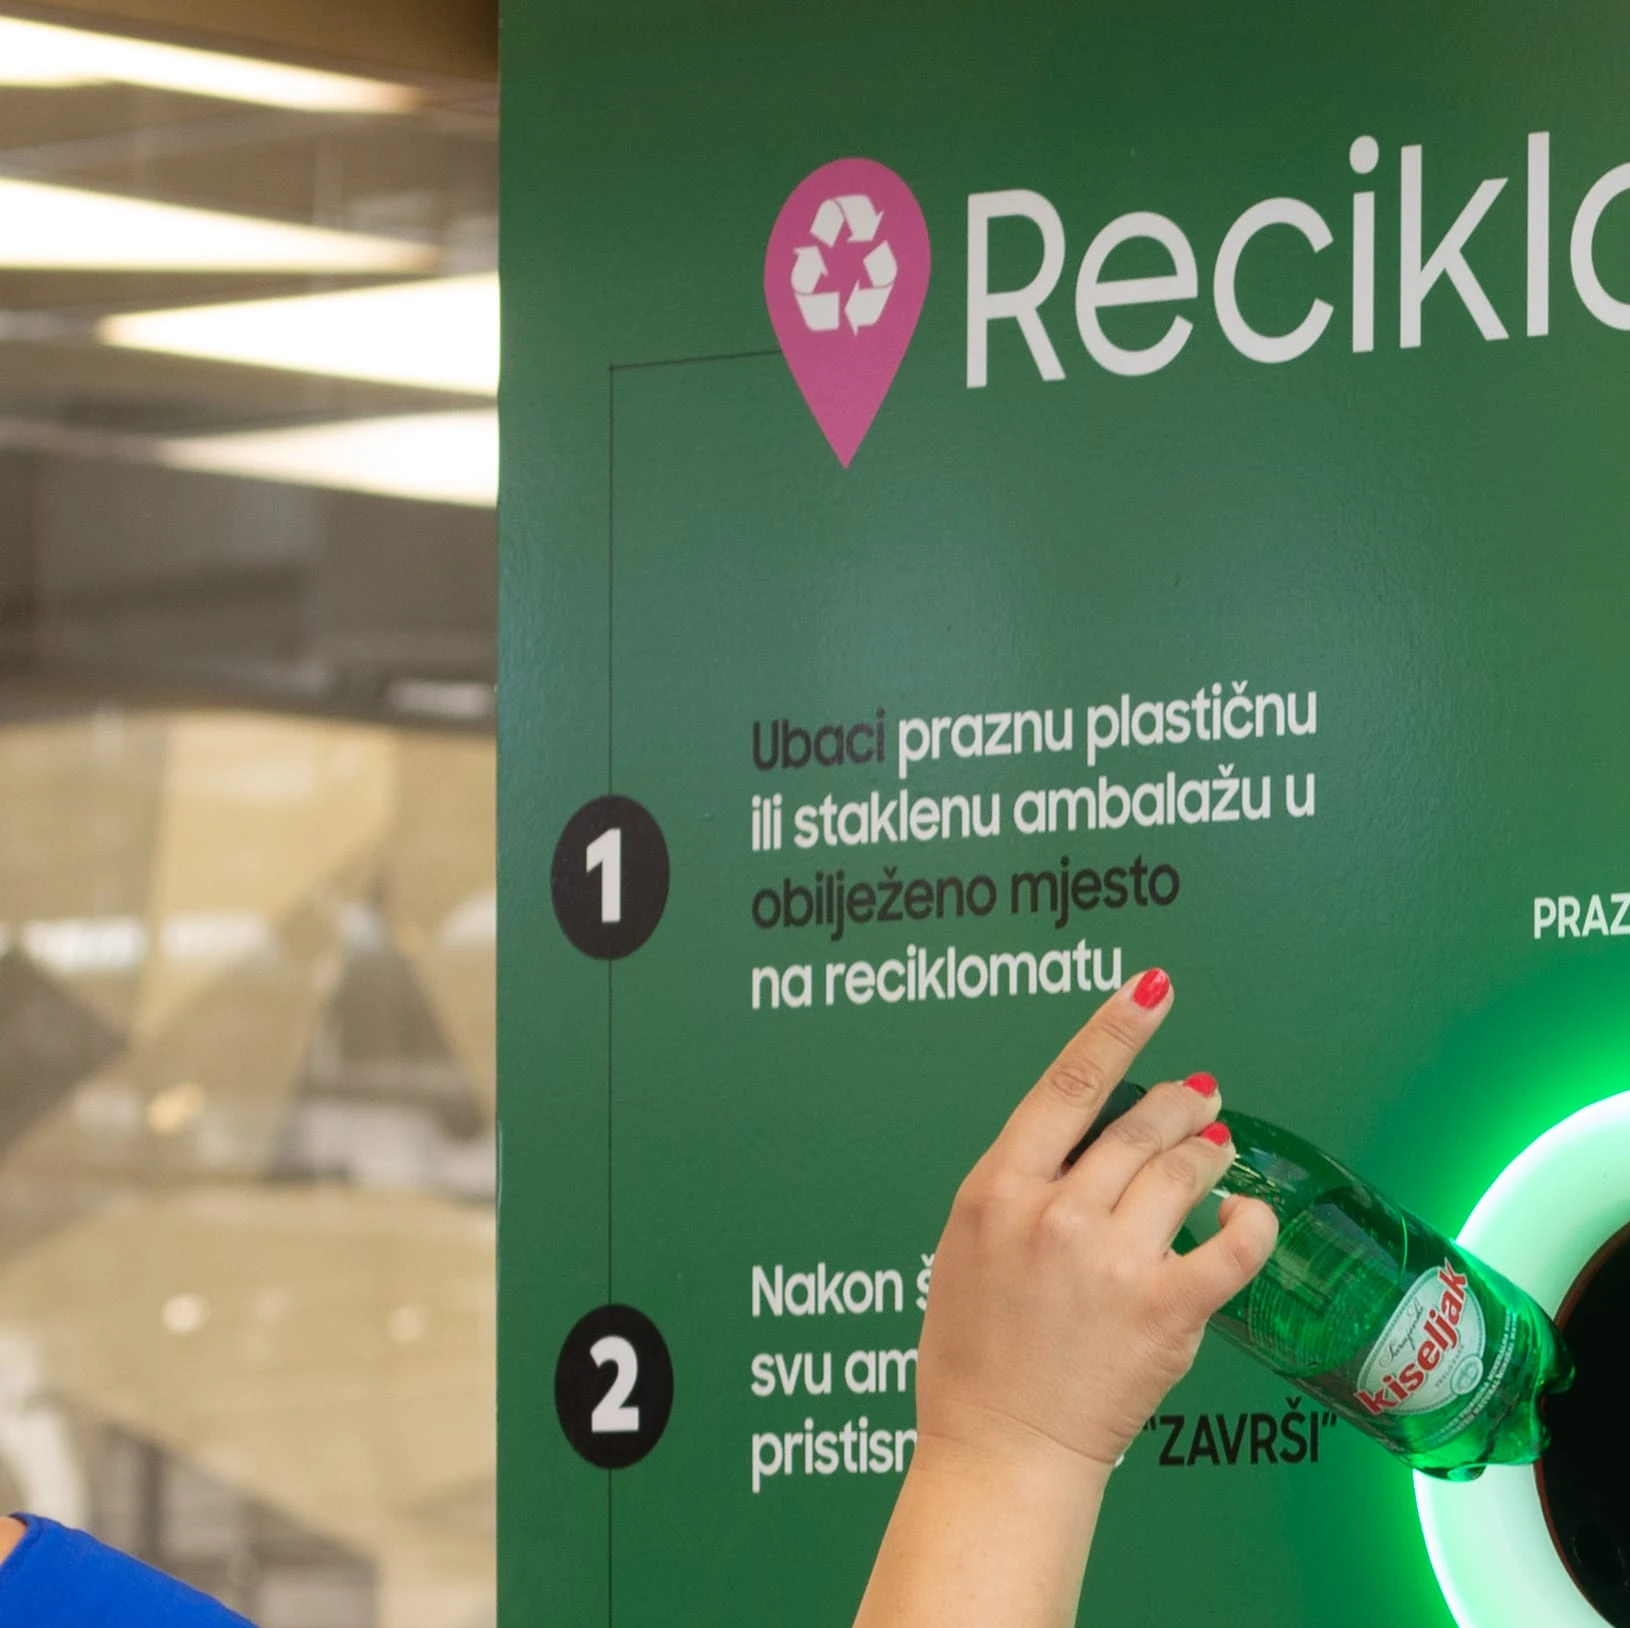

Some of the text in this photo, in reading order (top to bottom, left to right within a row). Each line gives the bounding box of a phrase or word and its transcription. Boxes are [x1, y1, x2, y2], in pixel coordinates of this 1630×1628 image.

[752, 680, 1317, 779] Ubaci praznu plastičnu
[751, 763, 1316, 851] ili staklenu ambalažu u
[587, 828, 621, 922] 1
[751, 854, 1181, 943] obilježeno mjesto
[752, 938, 1122, 1009] na reciklomatu
[752, 1261, 904, 1317] Nakon
[751, 1352, 832, 1397] svu
[1354, 1257, 1468, 1416] kiseljak
[590, 1336, 639, 1431] 2
